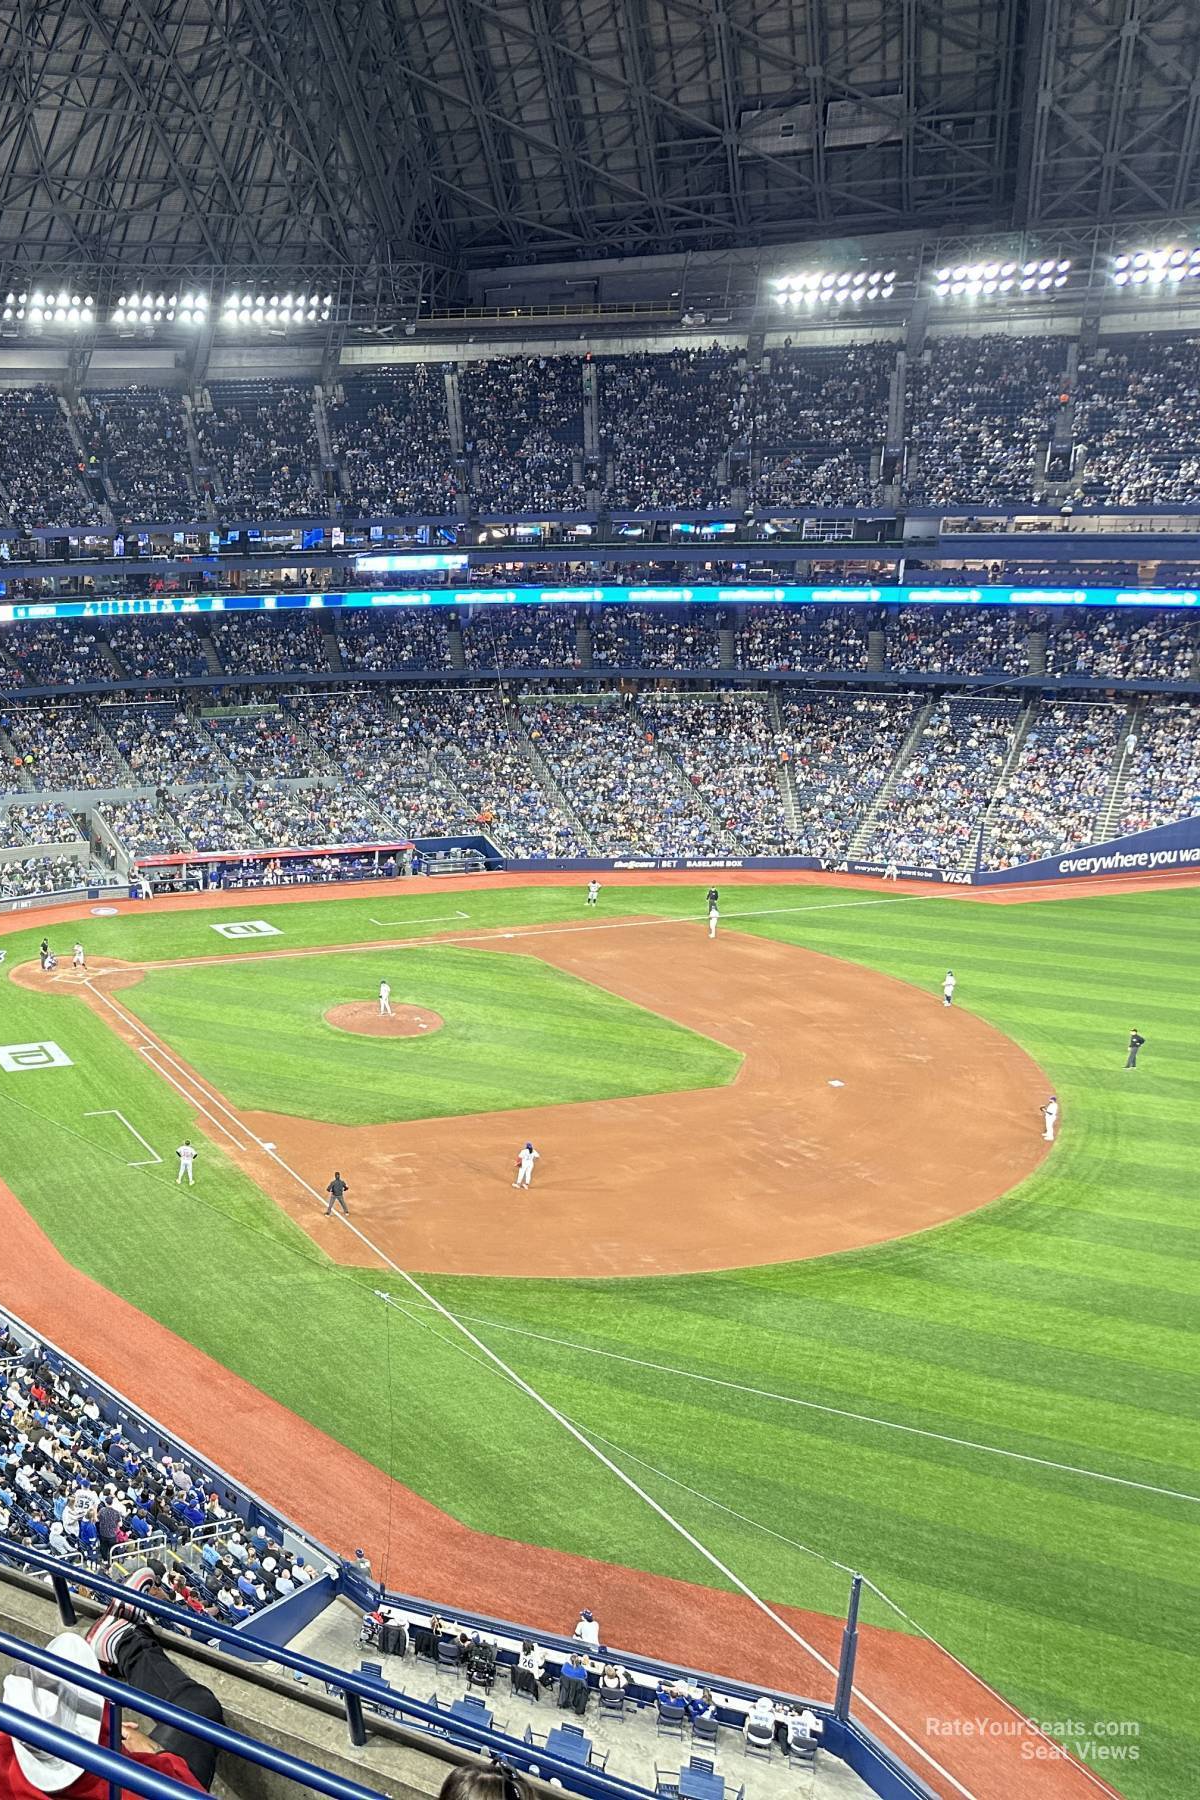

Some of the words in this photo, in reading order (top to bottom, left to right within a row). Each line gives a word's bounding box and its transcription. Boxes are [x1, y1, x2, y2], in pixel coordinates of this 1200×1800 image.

[661, 860, 678, 868] BET
[686, 860, 725, 868] BASELINE
[725, 860, 743, 868] BOX
[1058, 851, 1148, 874] everywhere
[1147, 850, 1178, 868] you
[940, 871, 973, 884] VISA
[522, 1657, 534, 1668] 26
